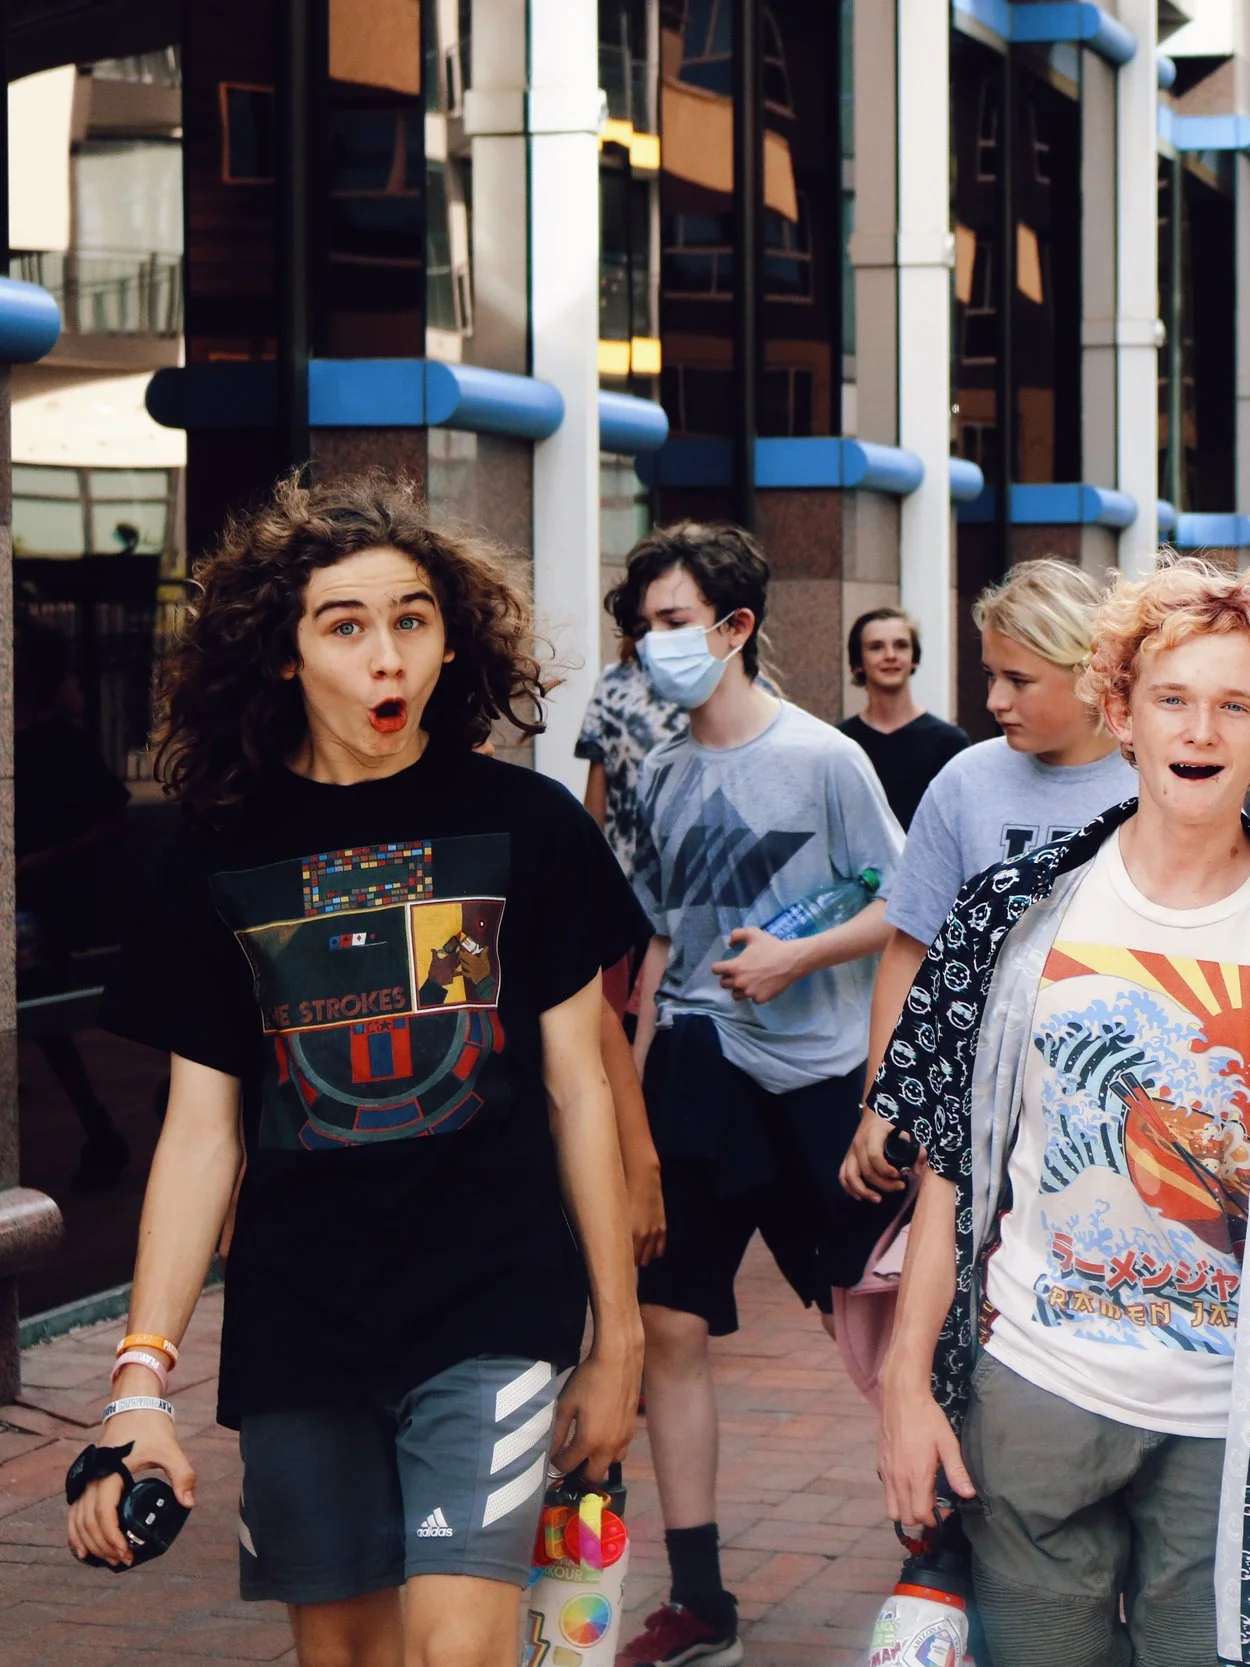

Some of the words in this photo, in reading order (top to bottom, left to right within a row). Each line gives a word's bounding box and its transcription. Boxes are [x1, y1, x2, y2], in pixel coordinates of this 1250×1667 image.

[299, 986, 405, 1022] STROKES
[1050, 1284, 1172, 1327] RAMEN
[1190, 1299, 1239, 1329] JA
[416, 1526, 454, 1538] adidas
[912, 1625, 943, 1650] ARIZONA
